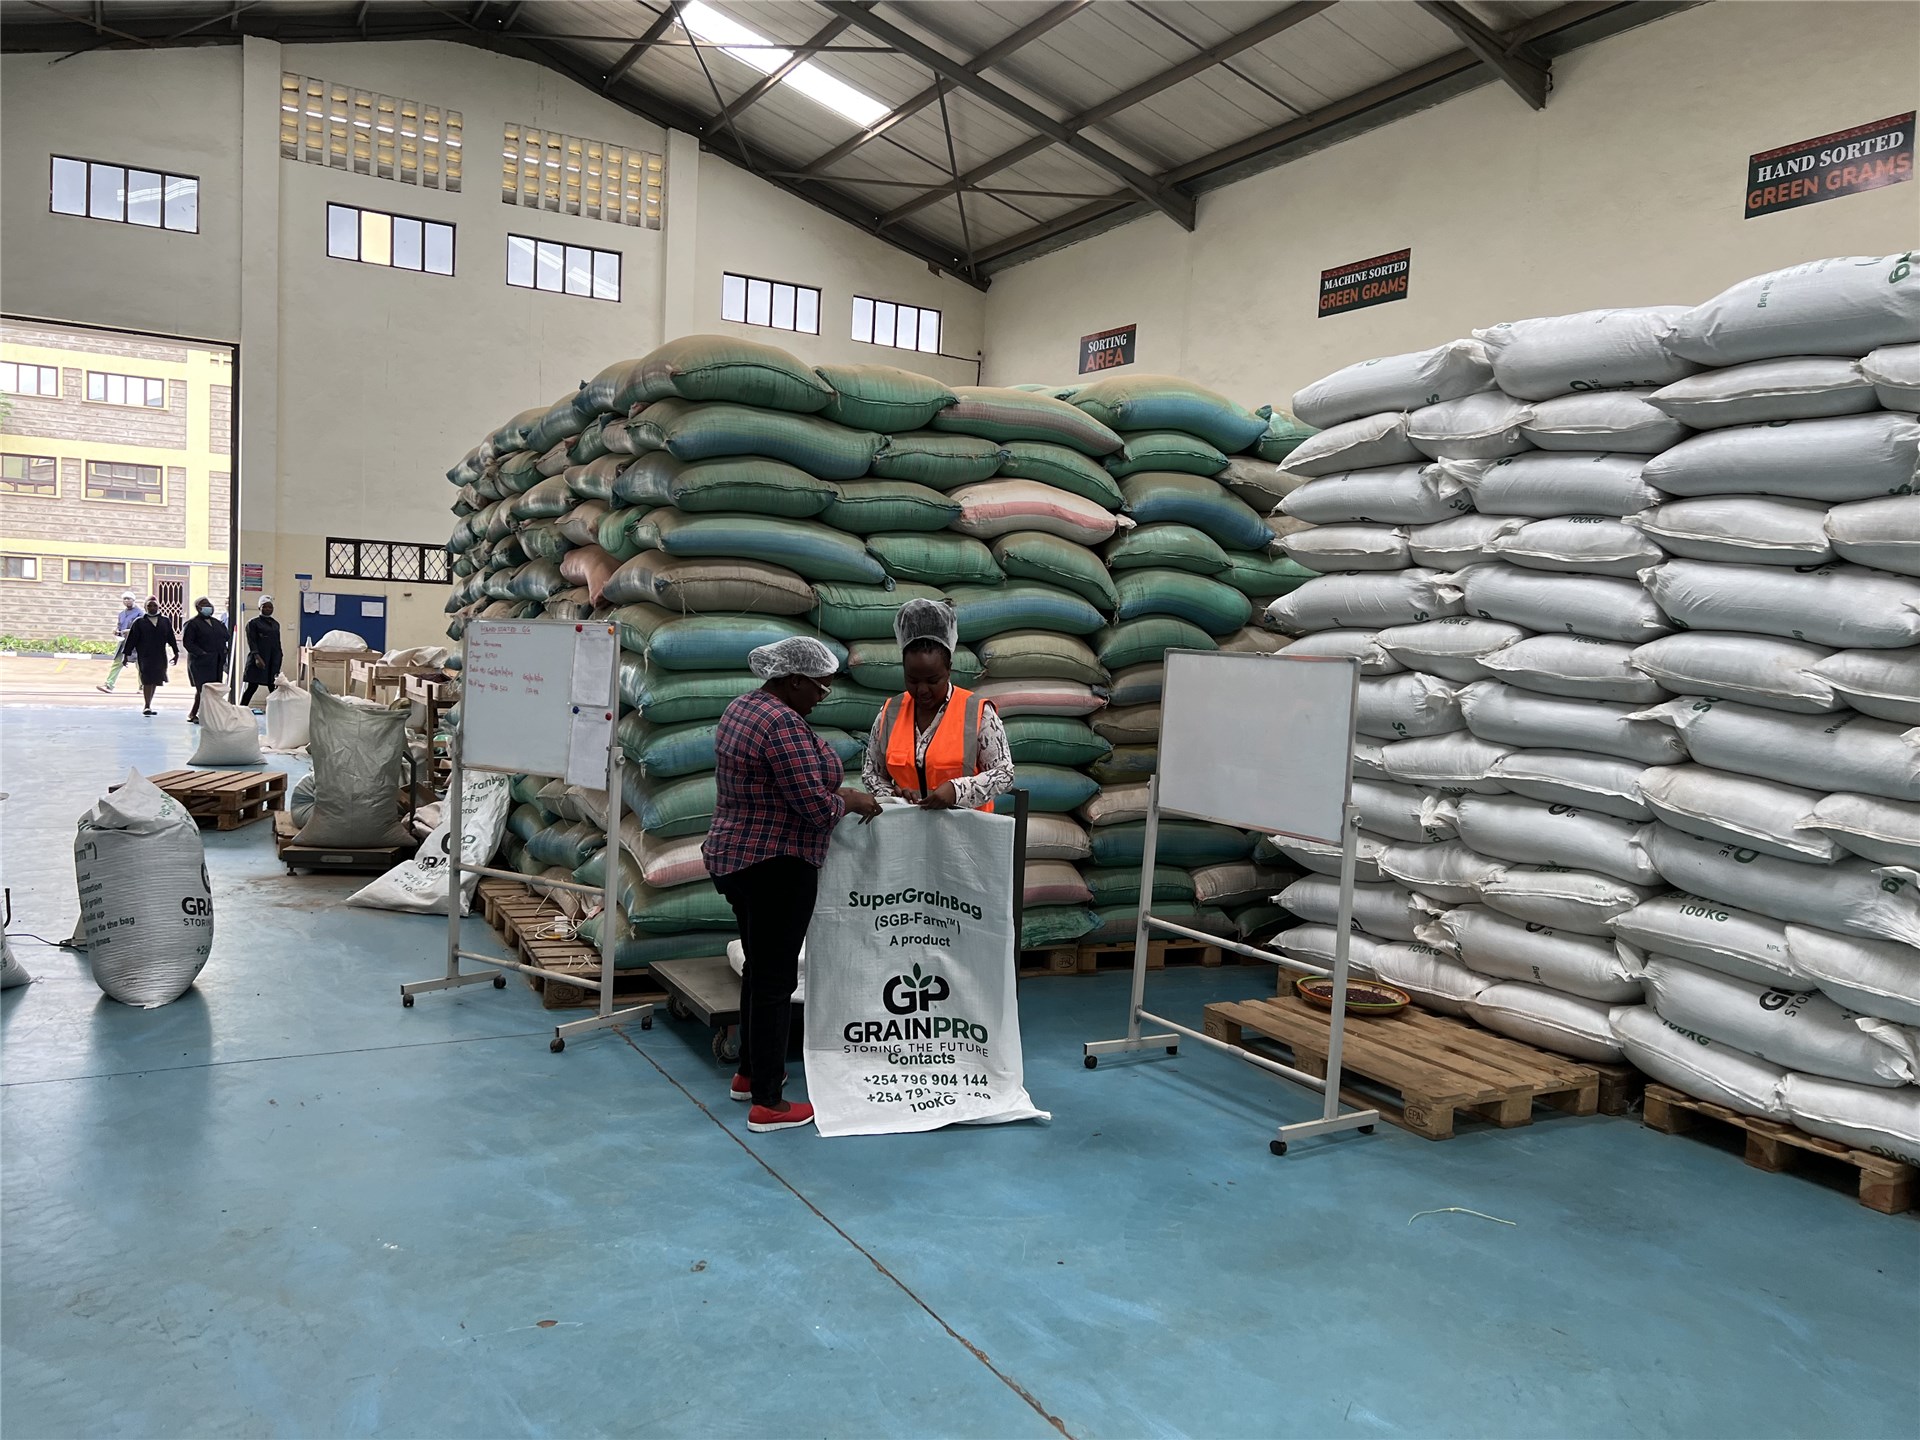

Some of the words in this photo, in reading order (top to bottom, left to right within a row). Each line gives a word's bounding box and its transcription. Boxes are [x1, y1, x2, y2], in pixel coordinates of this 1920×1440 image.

[1756, 154, 1816, 183] HAND
[1819, 131, 1905, 167] SORTED
[1748, 175, 1819, 209] GREEN
[1825, 152, 1911, 191] GRAMS
[1323, 271, 1368, 290] MACHINE
[1368, 260, 1407, 279] SORTED
[1320, 287, 1359, 309] GREEN
[1362, 275, 1406, 300] GRAMS
[1757, 291, 1771, 308] bag
[1087, 333, 1127, 353] SORTING
[1085, 347, 1124, 371] AREA
[1568, 516, 1605, 524] 100KG
[848, 887, 983, 920] SuperGrainBag
[119, 917, 135, 925] bag
[1679, 904, 1730, 922] 100KG
[889, 935, 899, 946] A
[901, 934, 951, 947] product
[843, 1016, 989, 1044] GRAINPRO
[843, 1044, 902, 1054] STORING
[908, 1043, 933, 1053] THE
[940, 1041, 989, 1058] FUTURE
[887, 1052, 956, 1066] Contacts
[863, 1074, 898, 1086] +254
[901, 1074, 927, 1086] 796
[931, 1074, 958, 1086] 904
[962, 1074, 988, 1087] 144
[867, 1091, 903, 1103] +254
[910, 1094, 957, 1113] 100KG
